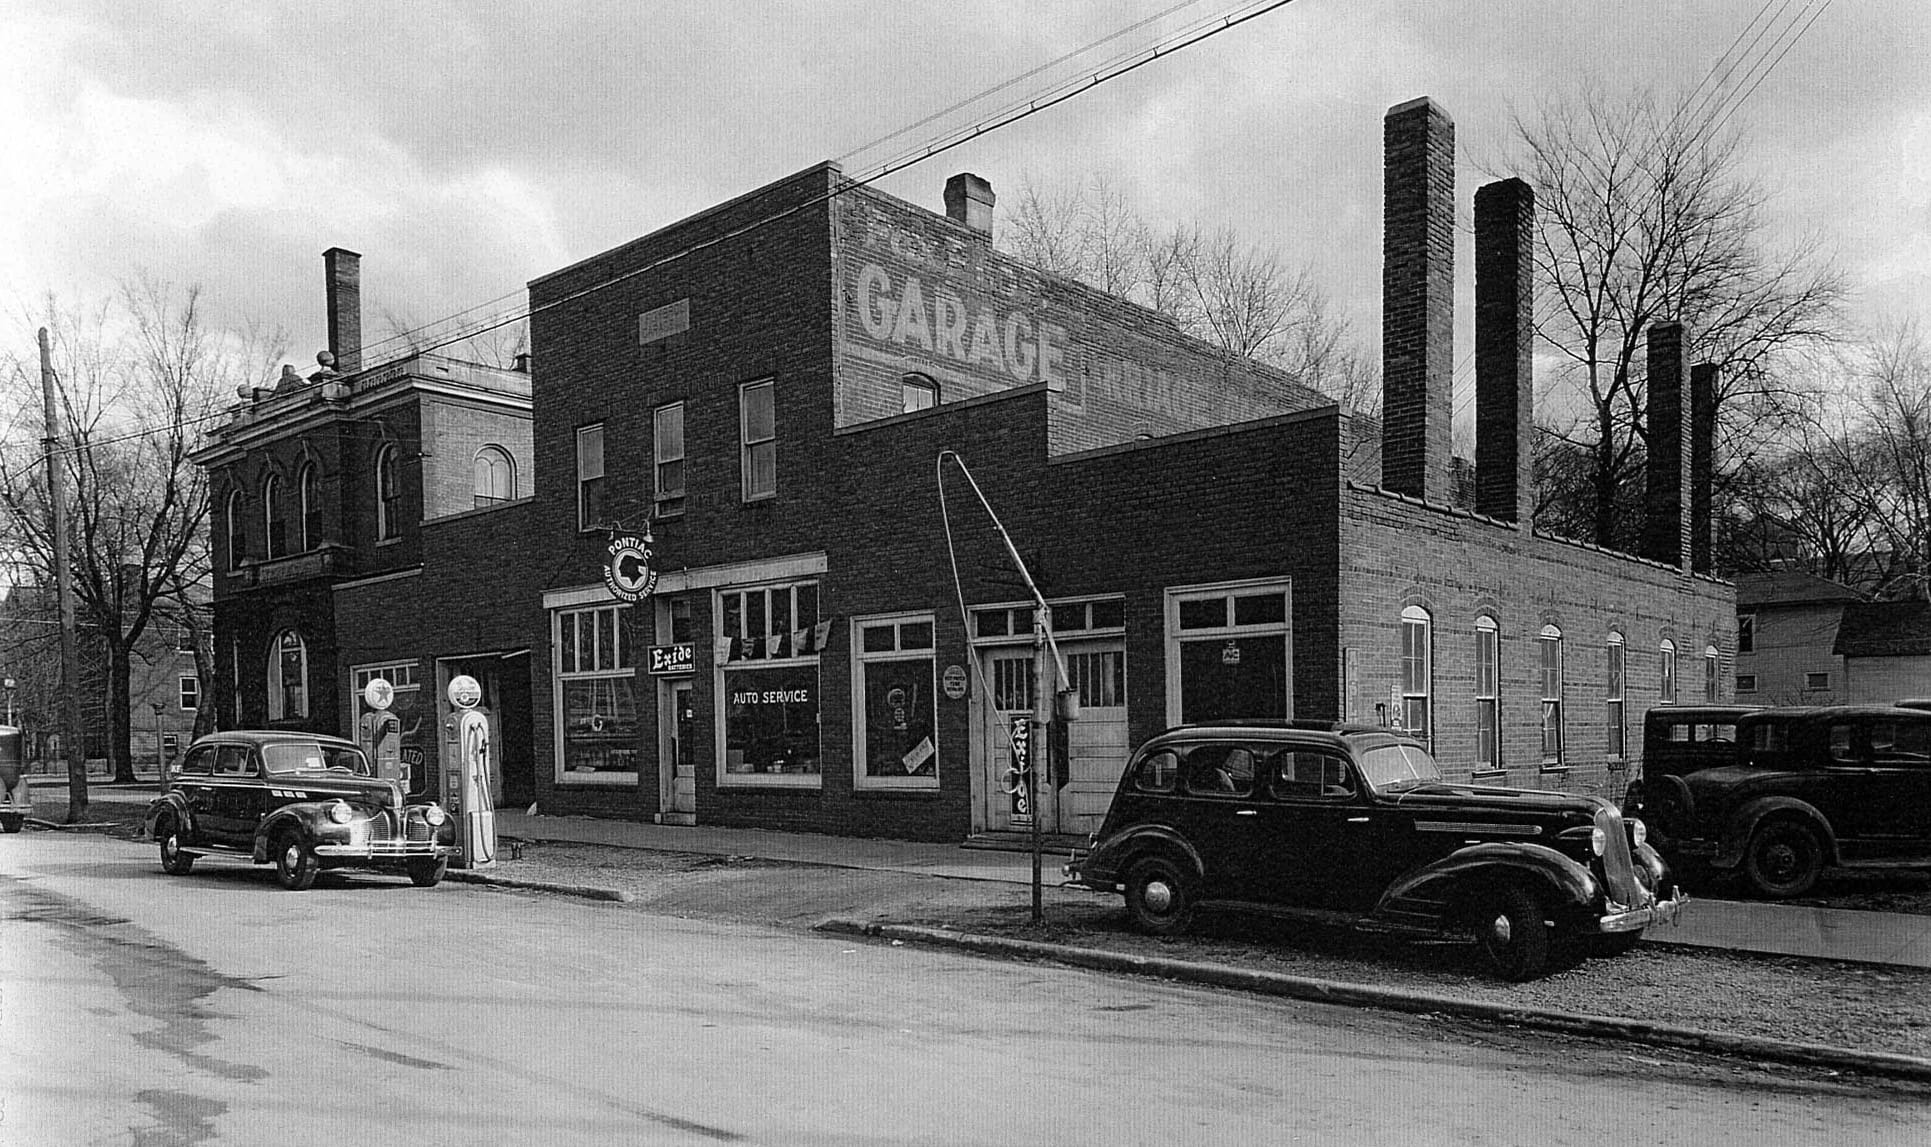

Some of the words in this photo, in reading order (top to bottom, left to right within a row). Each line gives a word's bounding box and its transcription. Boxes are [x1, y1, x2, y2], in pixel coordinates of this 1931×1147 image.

[857, 262, 1068, 393] GARAGE
[608, 537, 653, 559] PONTIAC
[603, 565, 637, 601] AUTHORIZED
[638, 570, 657, 599] SERVICE
[653, 646, 692, 670] Exide
[733, 692, 759, 704] AUTO
[762, 690, 808, 704] SERVICE
